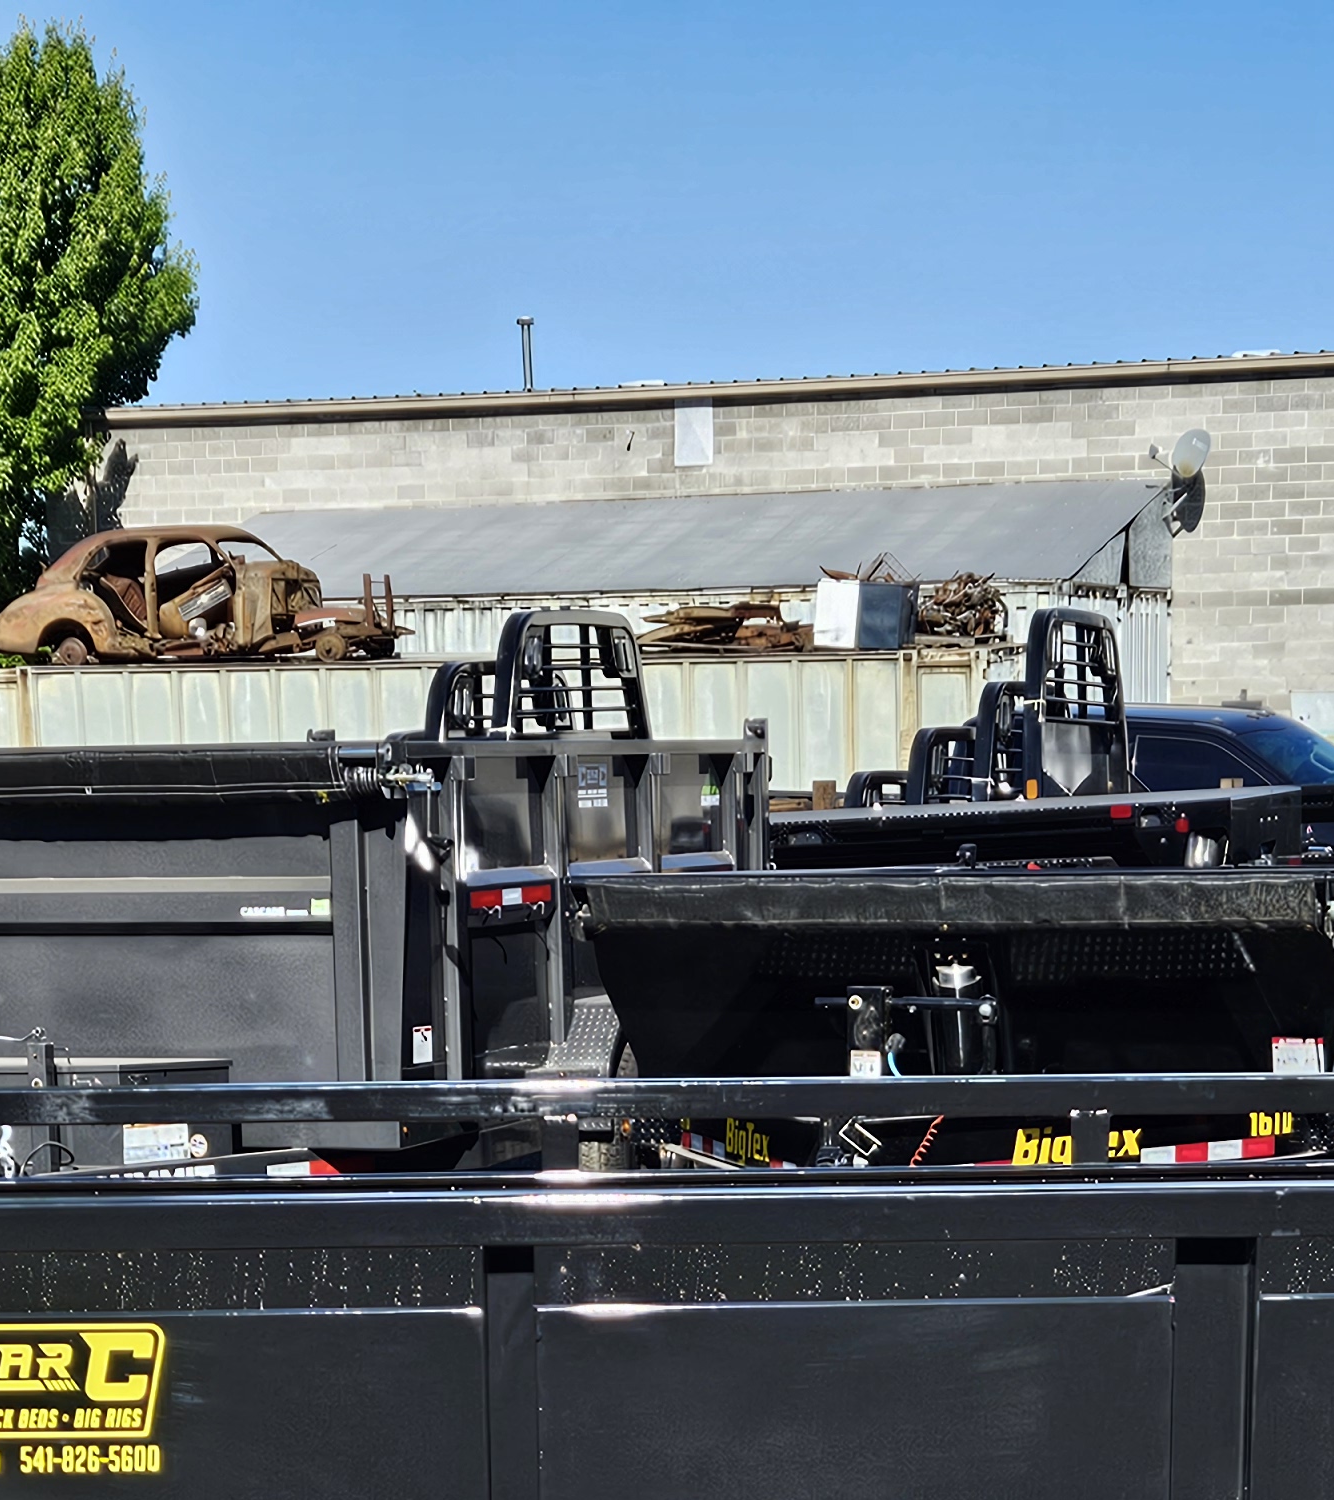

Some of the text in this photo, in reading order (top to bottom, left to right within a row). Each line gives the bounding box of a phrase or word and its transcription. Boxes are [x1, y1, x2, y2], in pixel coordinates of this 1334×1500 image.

[725, 1117, 771, 1166] BigTex
[79, 1332, 155, 1402] C
[18, 1408, 59, 1429] BEDS
[73, 1408, 101, 1429] BIG
[105, 1408, 143, 1428] RIGS
[19, 1444, 161, 1474] 541-826-5600
